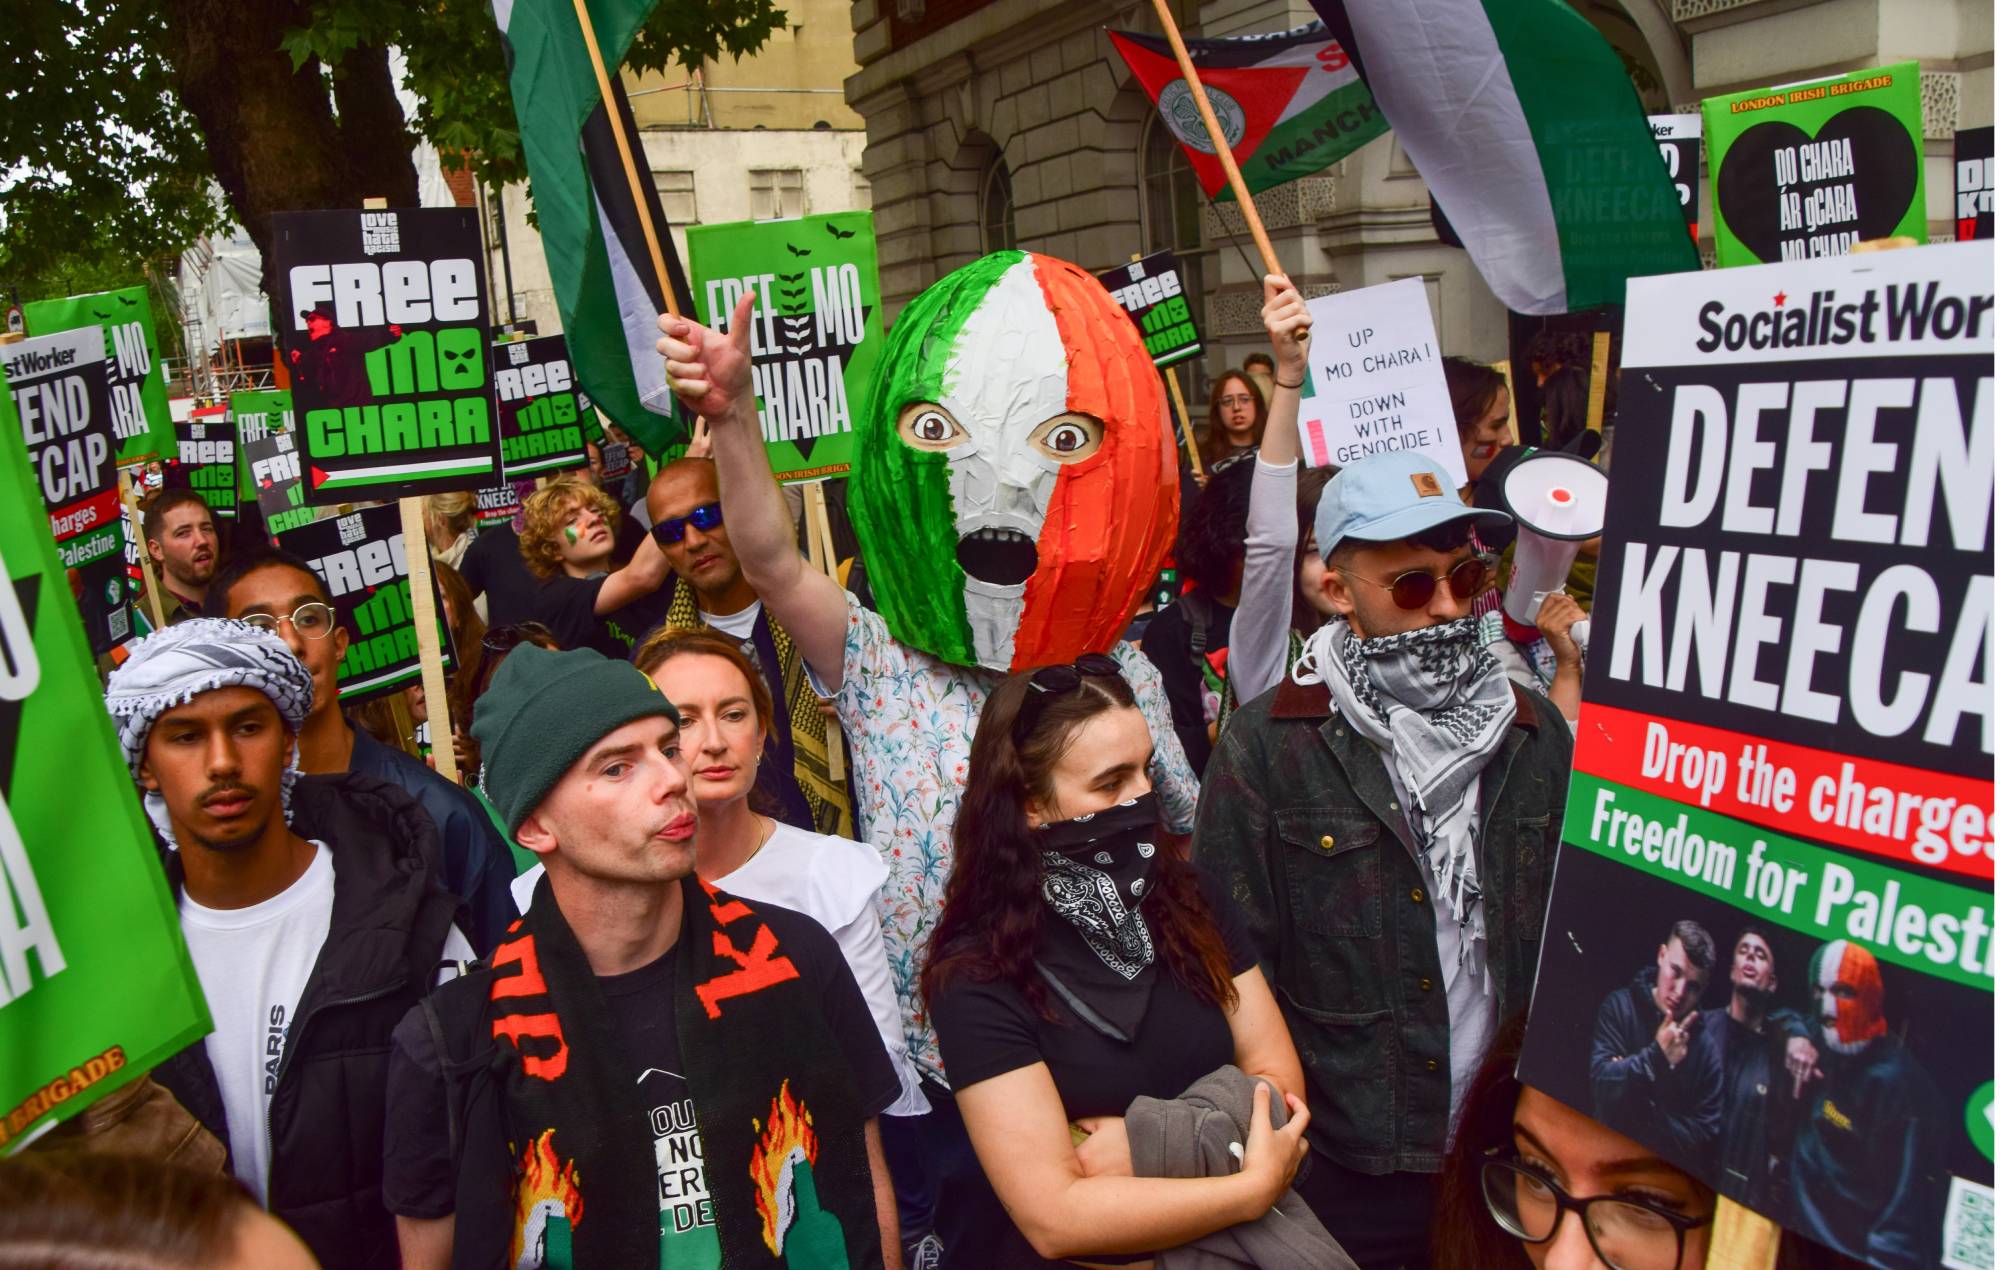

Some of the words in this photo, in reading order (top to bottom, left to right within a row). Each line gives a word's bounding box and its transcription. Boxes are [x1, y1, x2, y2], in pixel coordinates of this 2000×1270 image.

[1731, 94, 1785, 115] LONDON
[1789, 87, 1826, 104] IRISH
[1830, 75, 1893, 97] BRIGADE
[1774, 146, 1798, 186] DO
[1800, 137, 1855, 183] CHARA
[361, 212, 397, 230] love
[1780, 186, 1802, 231] ÁR
[1804, 183, 1858, 233] gCARA
[810, 263, 865, 348] MO
[1695, 289, 1880, 353] Socialist
[111, 321, 151, 379] MO
[1348, 328, 1374, 348] UP
[1325, 363, 1353, 381] MO
[11, 374, 91, 446] END
[306, 397, 491, 458] CHARA
[1350, 392, 1405, 419] DOWN
[1354, 414, 1403, 439] WITH
[29, 432, 108, 503] CAP
[1659, 376, 1994, 552] DEFEN
[1641, 721, 1727, 807] Drop
[1736, 744, 1796, 814] the
[1590, 788, 1737, 890] Freedom
[1745, 839, 1808, 914] for
[265, 1004, 285, 1095] PARIS
[8, 1044, 127, 1136] BRIGADE
